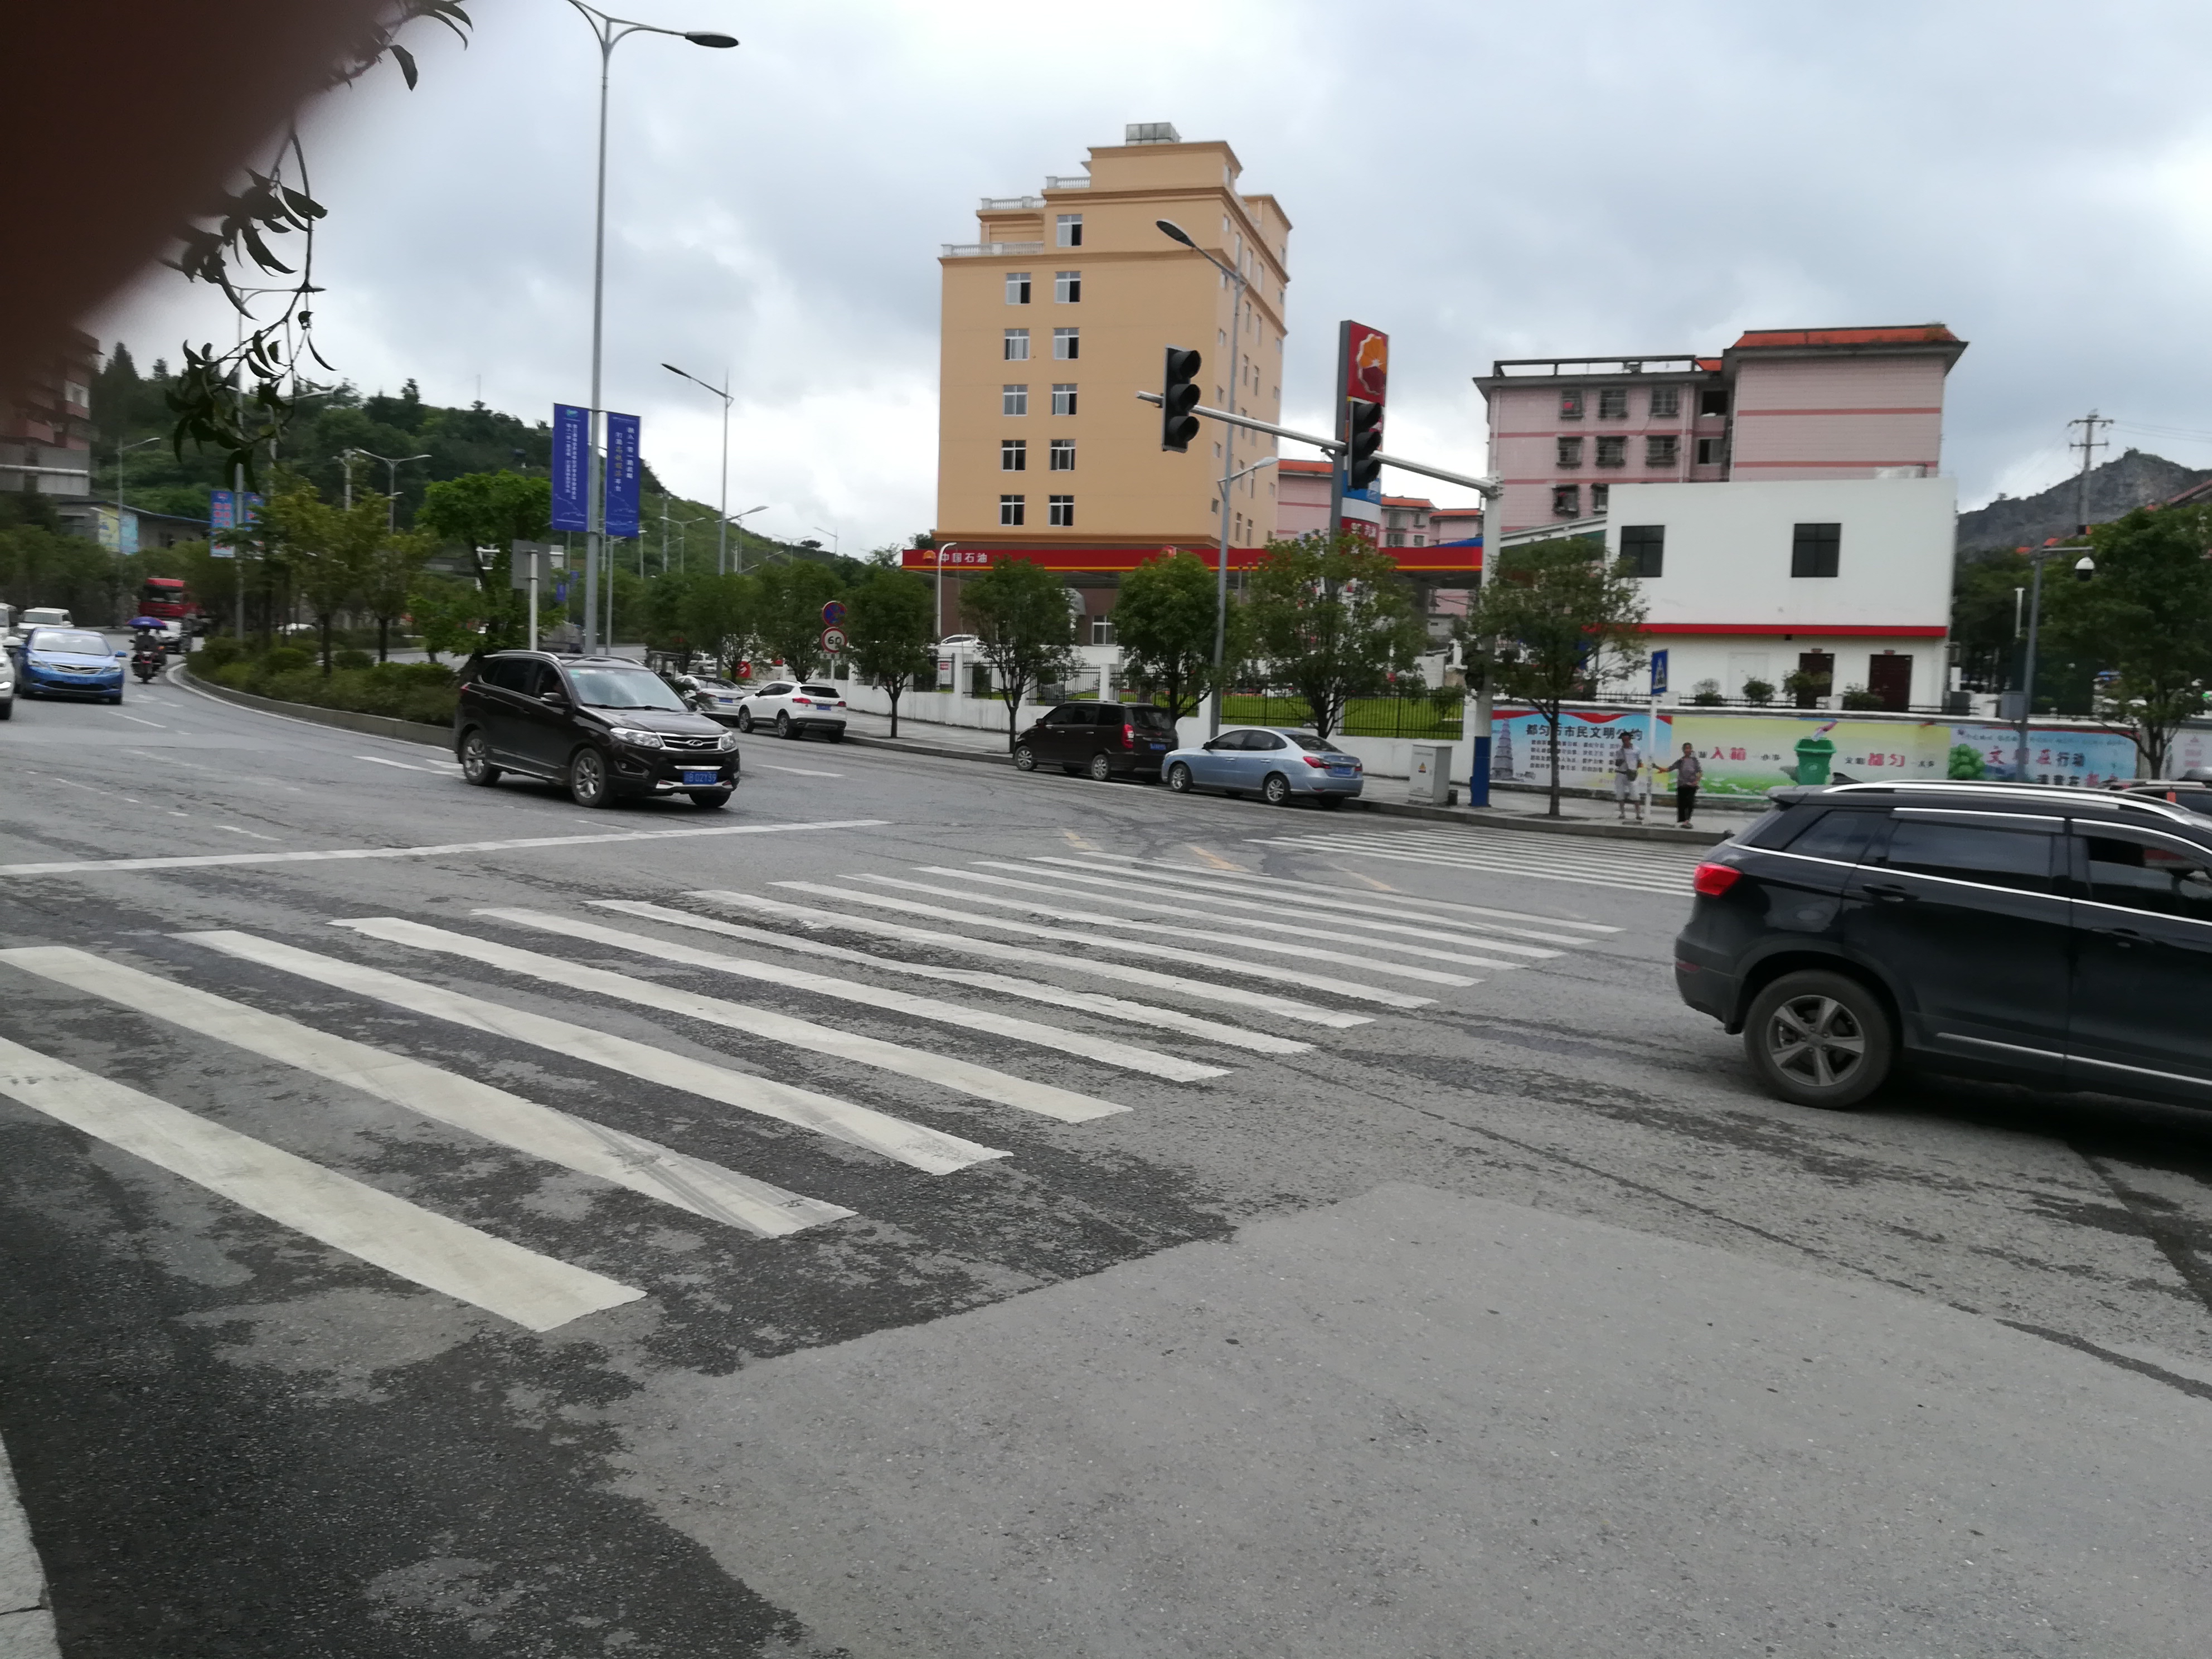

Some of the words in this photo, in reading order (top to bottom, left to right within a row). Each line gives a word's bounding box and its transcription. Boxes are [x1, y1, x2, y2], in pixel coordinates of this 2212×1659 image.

[940, 552, 987, 563] 中国石油
[828, 636, 842, 644] 60
